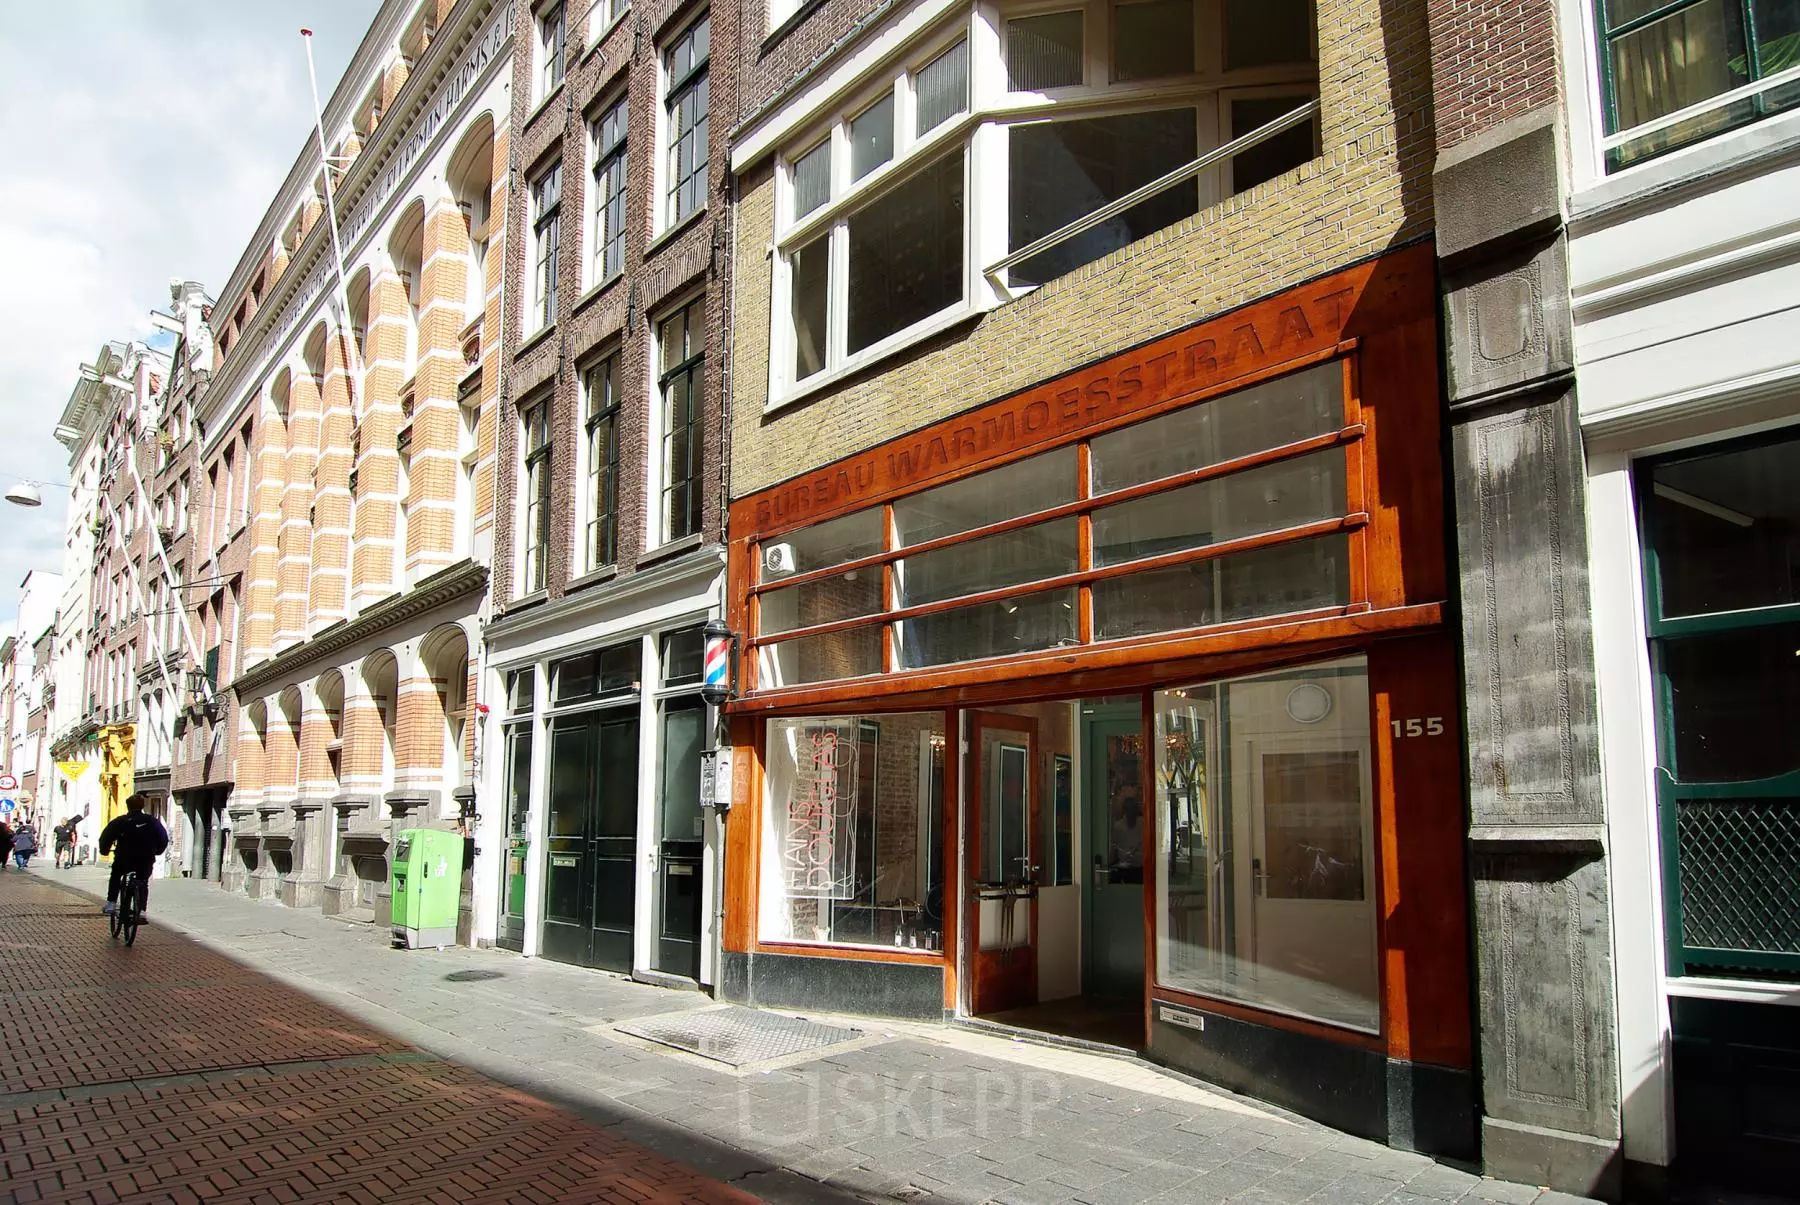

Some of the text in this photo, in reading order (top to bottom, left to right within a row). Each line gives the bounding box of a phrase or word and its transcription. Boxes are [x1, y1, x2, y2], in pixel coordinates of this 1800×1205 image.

[446, 34, 489, 118] HARMS
[756, 286, 1354, 527] BUREAU WARMOESSTRAAT
[1391, 717, 1443, 738] 155
[784, 801, 812, 890] HANS
[806, 732, 837, 890] DOUGLAS
